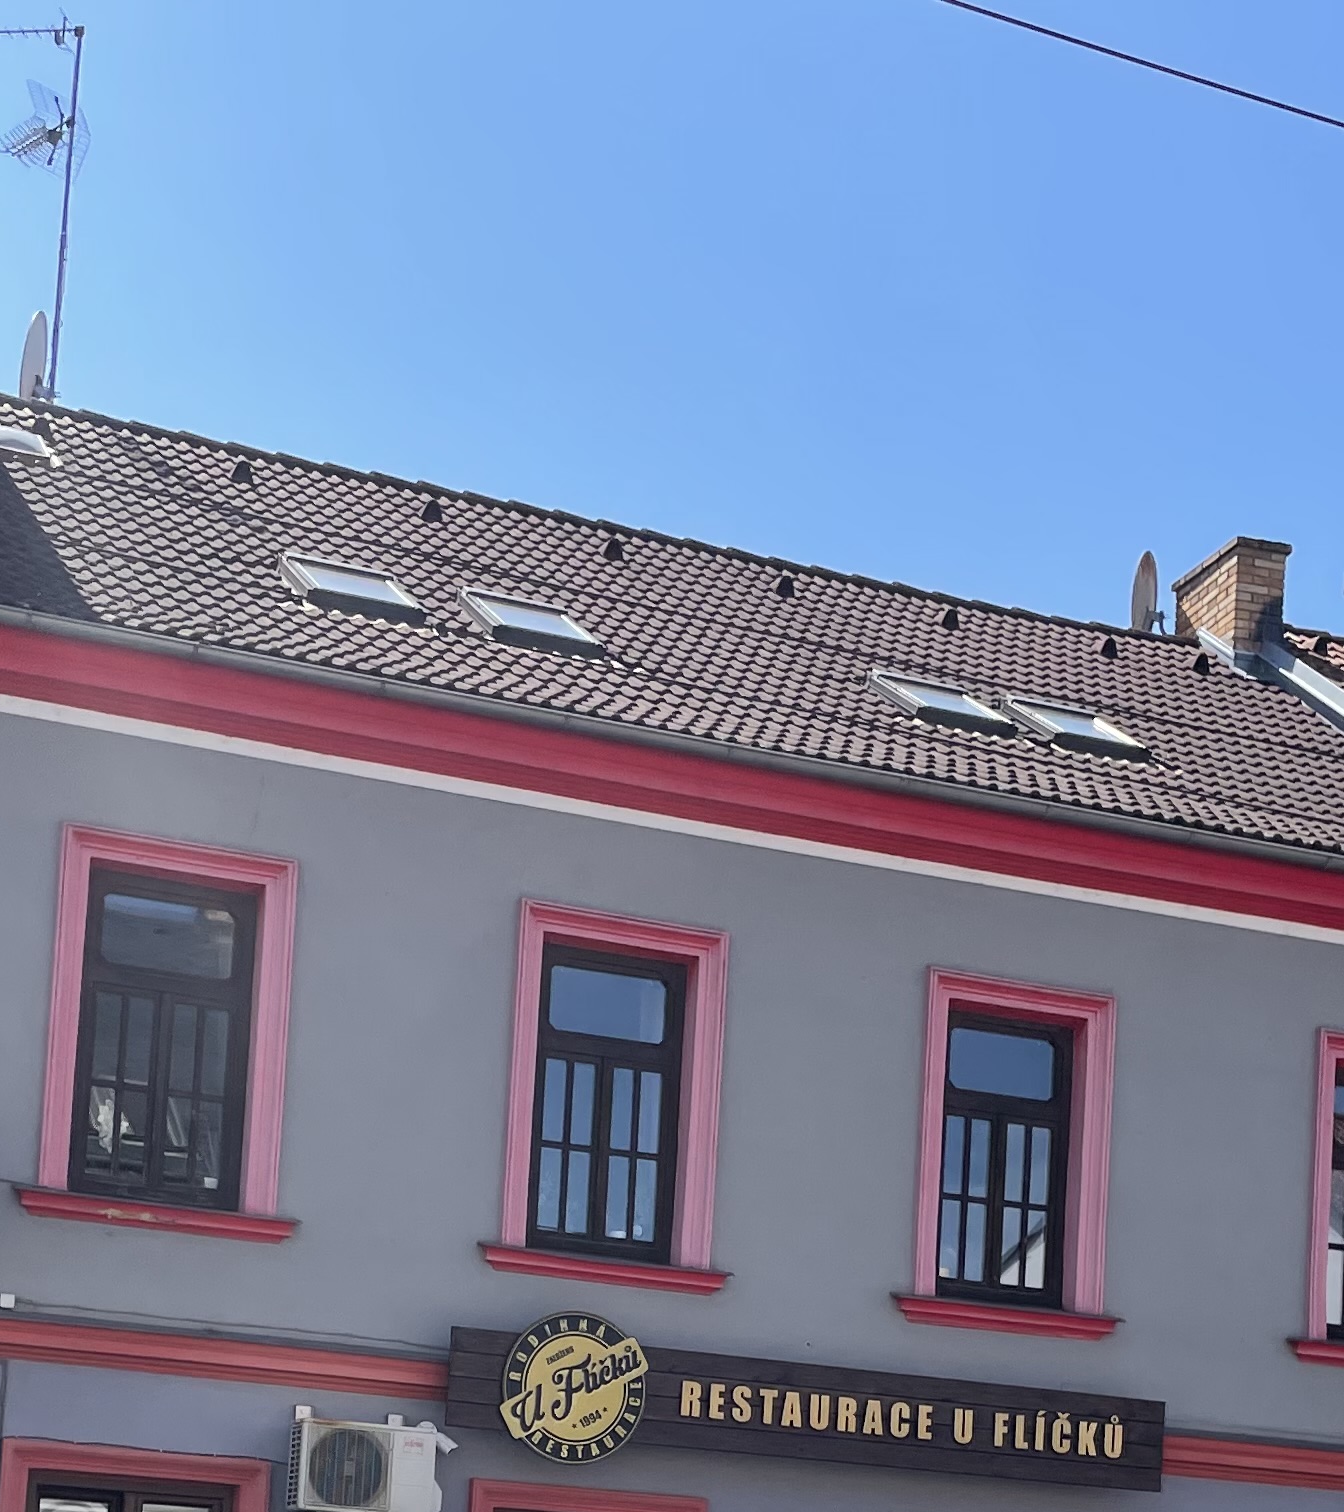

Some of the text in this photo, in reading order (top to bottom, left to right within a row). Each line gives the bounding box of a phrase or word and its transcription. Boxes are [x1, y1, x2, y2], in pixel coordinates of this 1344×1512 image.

[531, 1382, 642, 1459] RESTAURACE
[551, 1345, 642, 1421] Flíčků
[680, 1379, 1125, 1459] RESTAURACE U FLÍČKŮ
